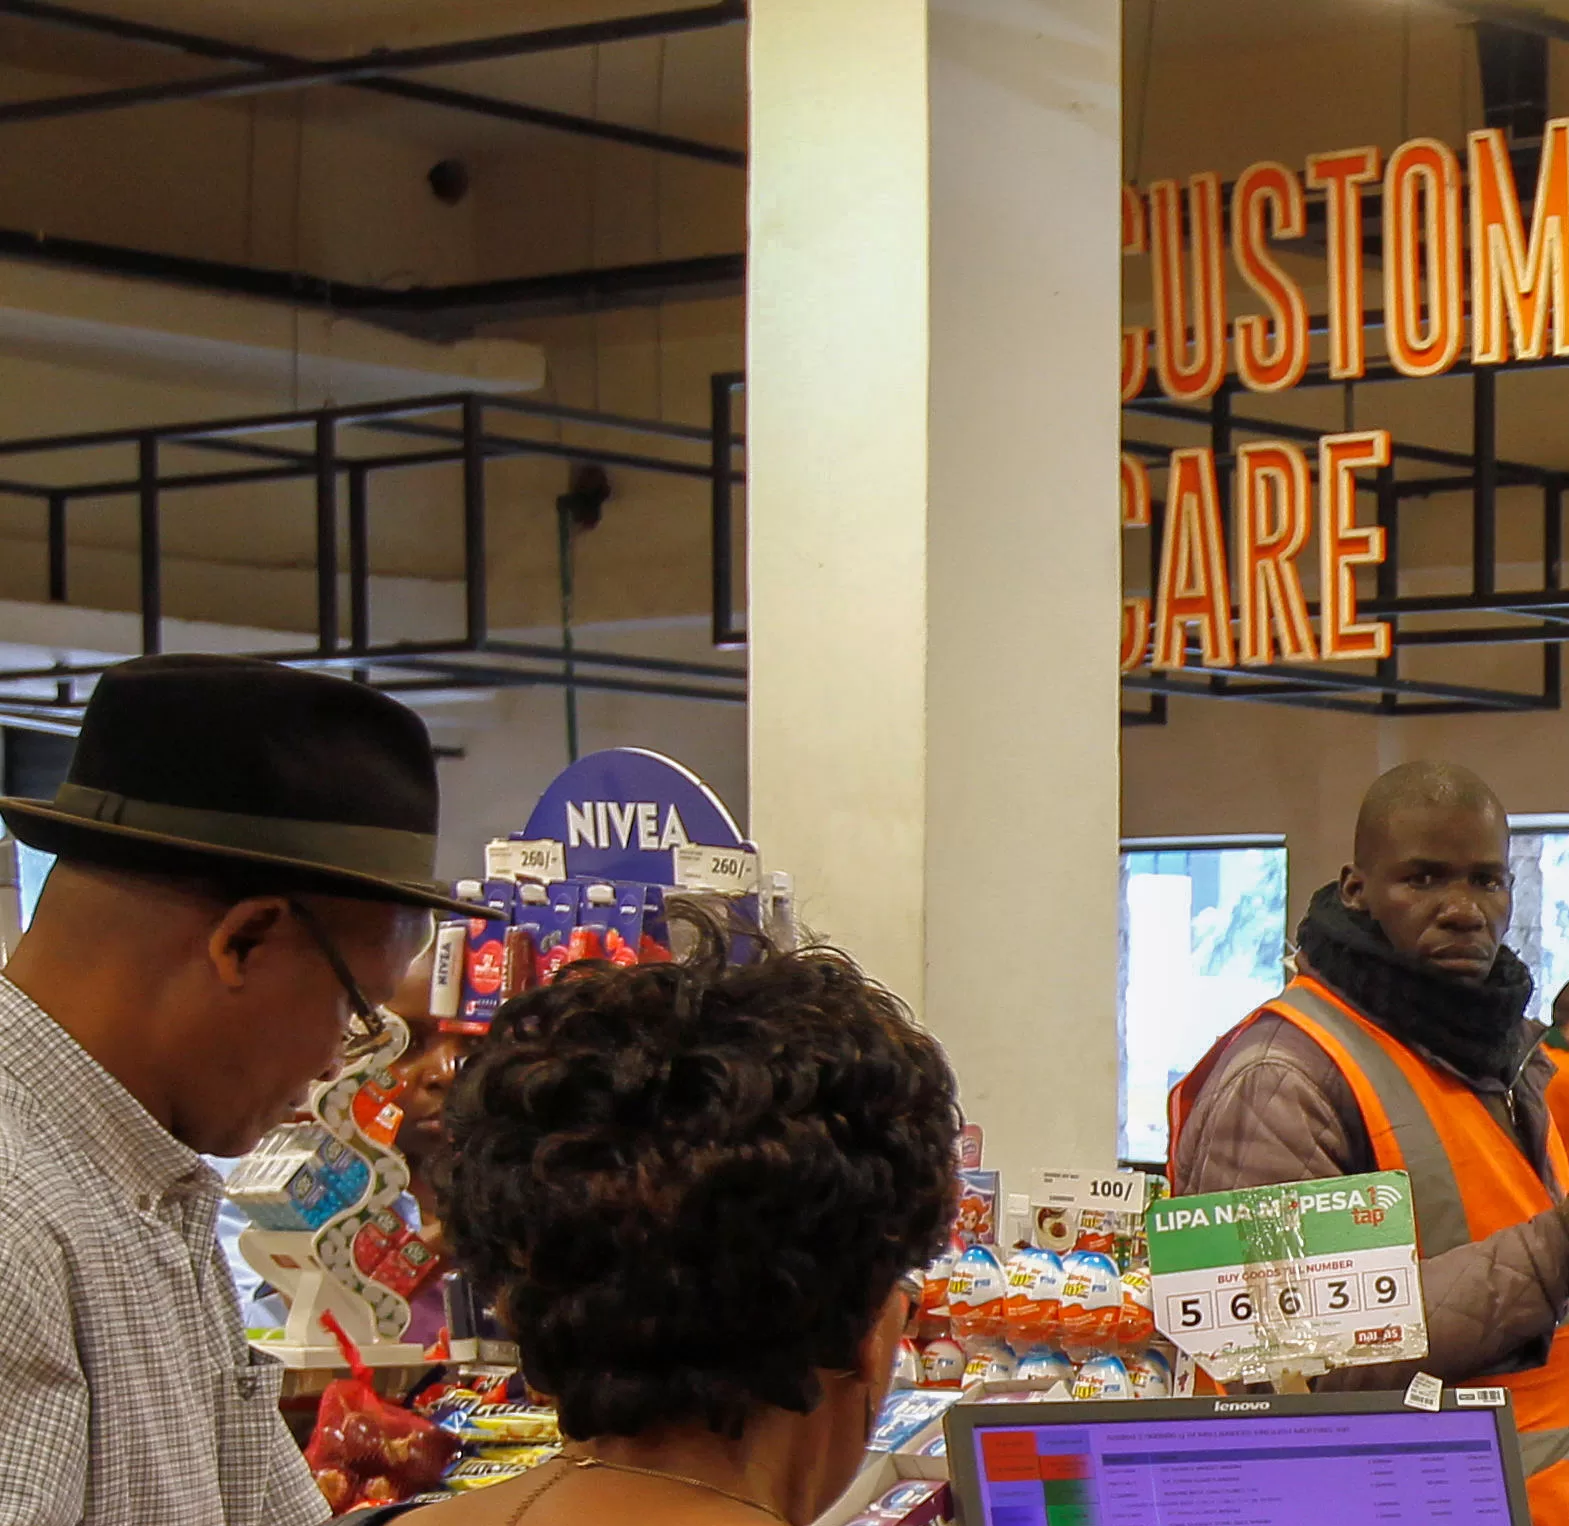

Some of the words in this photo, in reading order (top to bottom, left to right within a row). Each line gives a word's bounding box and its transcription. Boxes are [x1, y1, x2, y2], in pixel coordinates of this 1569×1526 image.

[566, 801, 690, 850] NIVEA
[521, 851, 558, 869] 260/-
[711, 857, 752, 878] 260/-
[438, 941, 450, 986] NIVEA
[1155, 1209, 1210, 1232] LIPA
[1215, 1201, 1254, 1225] NA
[1351, 1206, 1385, 1227] tap
[1217, 1272, 1240, 1284] BUY
[1242, 1267, 1281, 1281] GOODS
[1307, 1260, 1354, 1274] NUMBER
[1181, 1298, 1202, 1327] 5
[1230, 1293, 1254, 1321] 6
[1278, 1286, 1302, 1315] 6
[1327, 1280, 1350, 1309] 3
[1374, 1275, 1398, 1304] 9
[1214, 1400, 1271, 1413] lenovo
